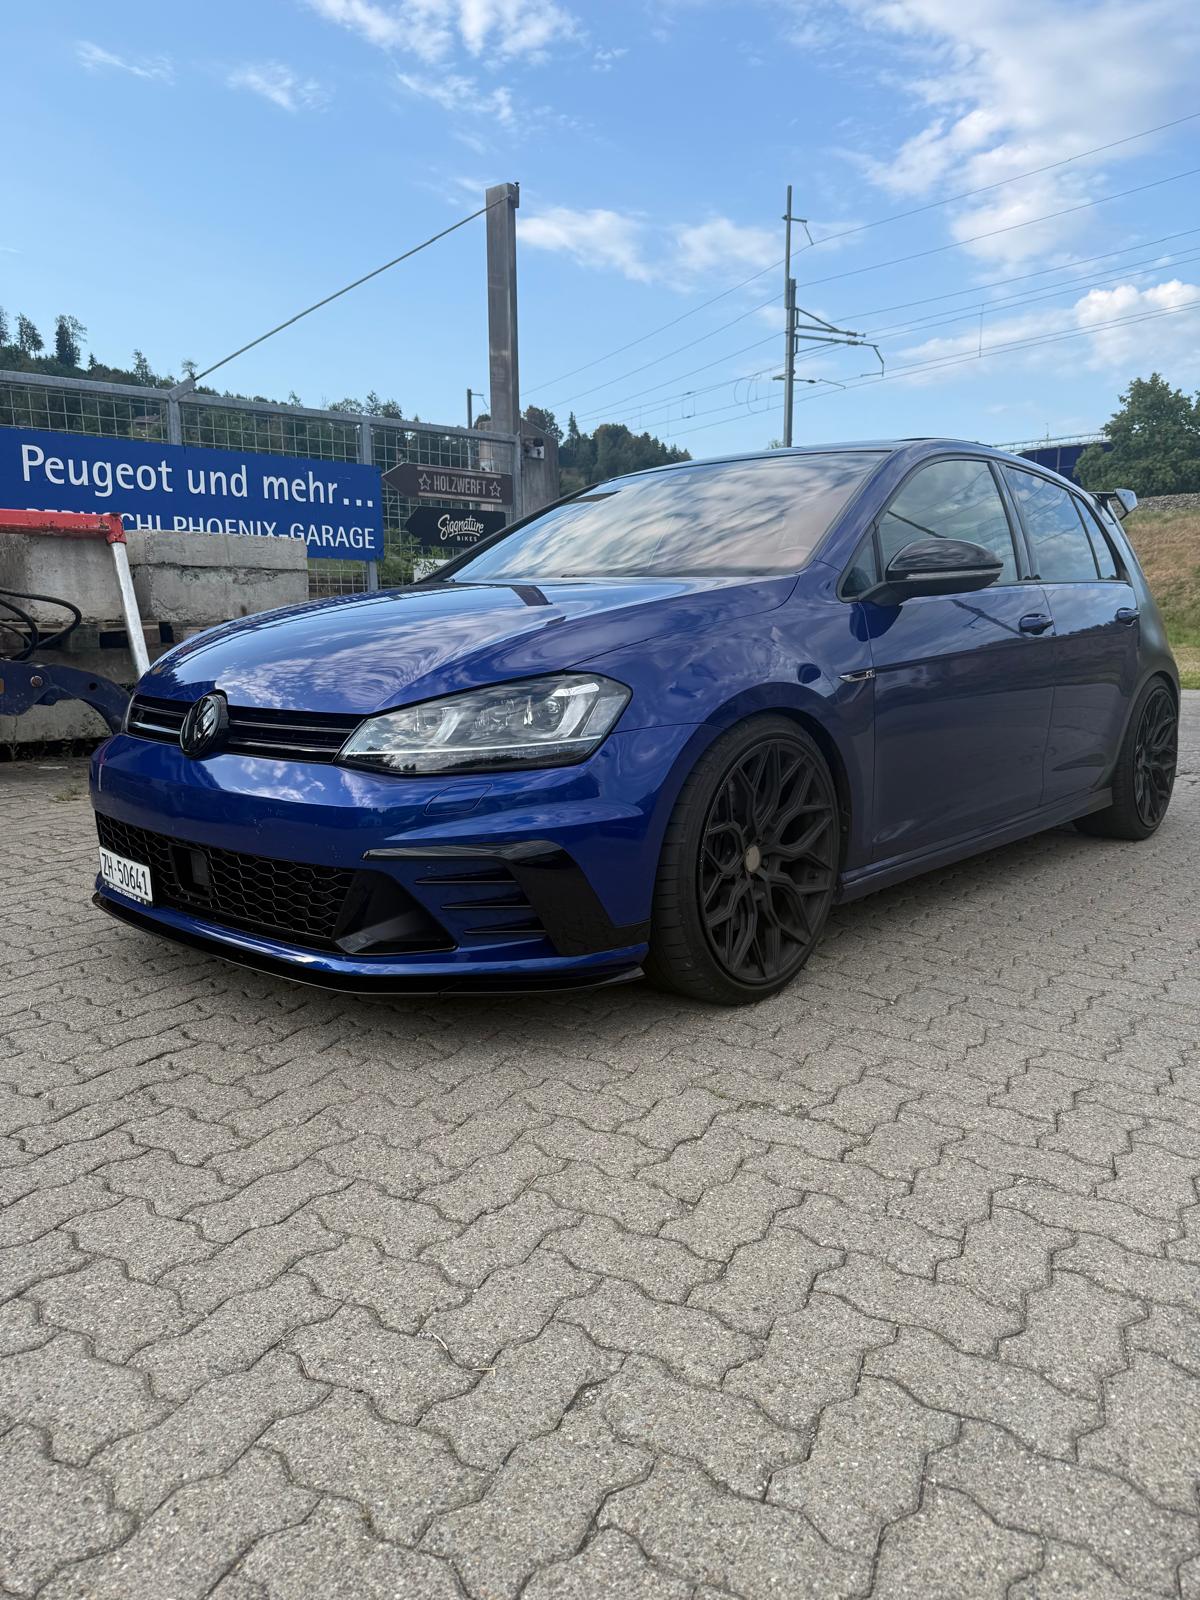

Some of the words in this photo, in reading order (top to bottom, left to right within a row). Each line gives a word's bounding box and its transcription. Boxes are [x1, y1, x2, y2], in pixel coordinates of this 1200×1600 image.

[21, 444, 173, 498] Peugeot
[187, 465, 249, 498] und
[262, 471, 374, 507] mehr...
[433, 475, 486, 495] HOLZWERFT
[173, 515, 376, 549] PHOENIX-GARAGE
